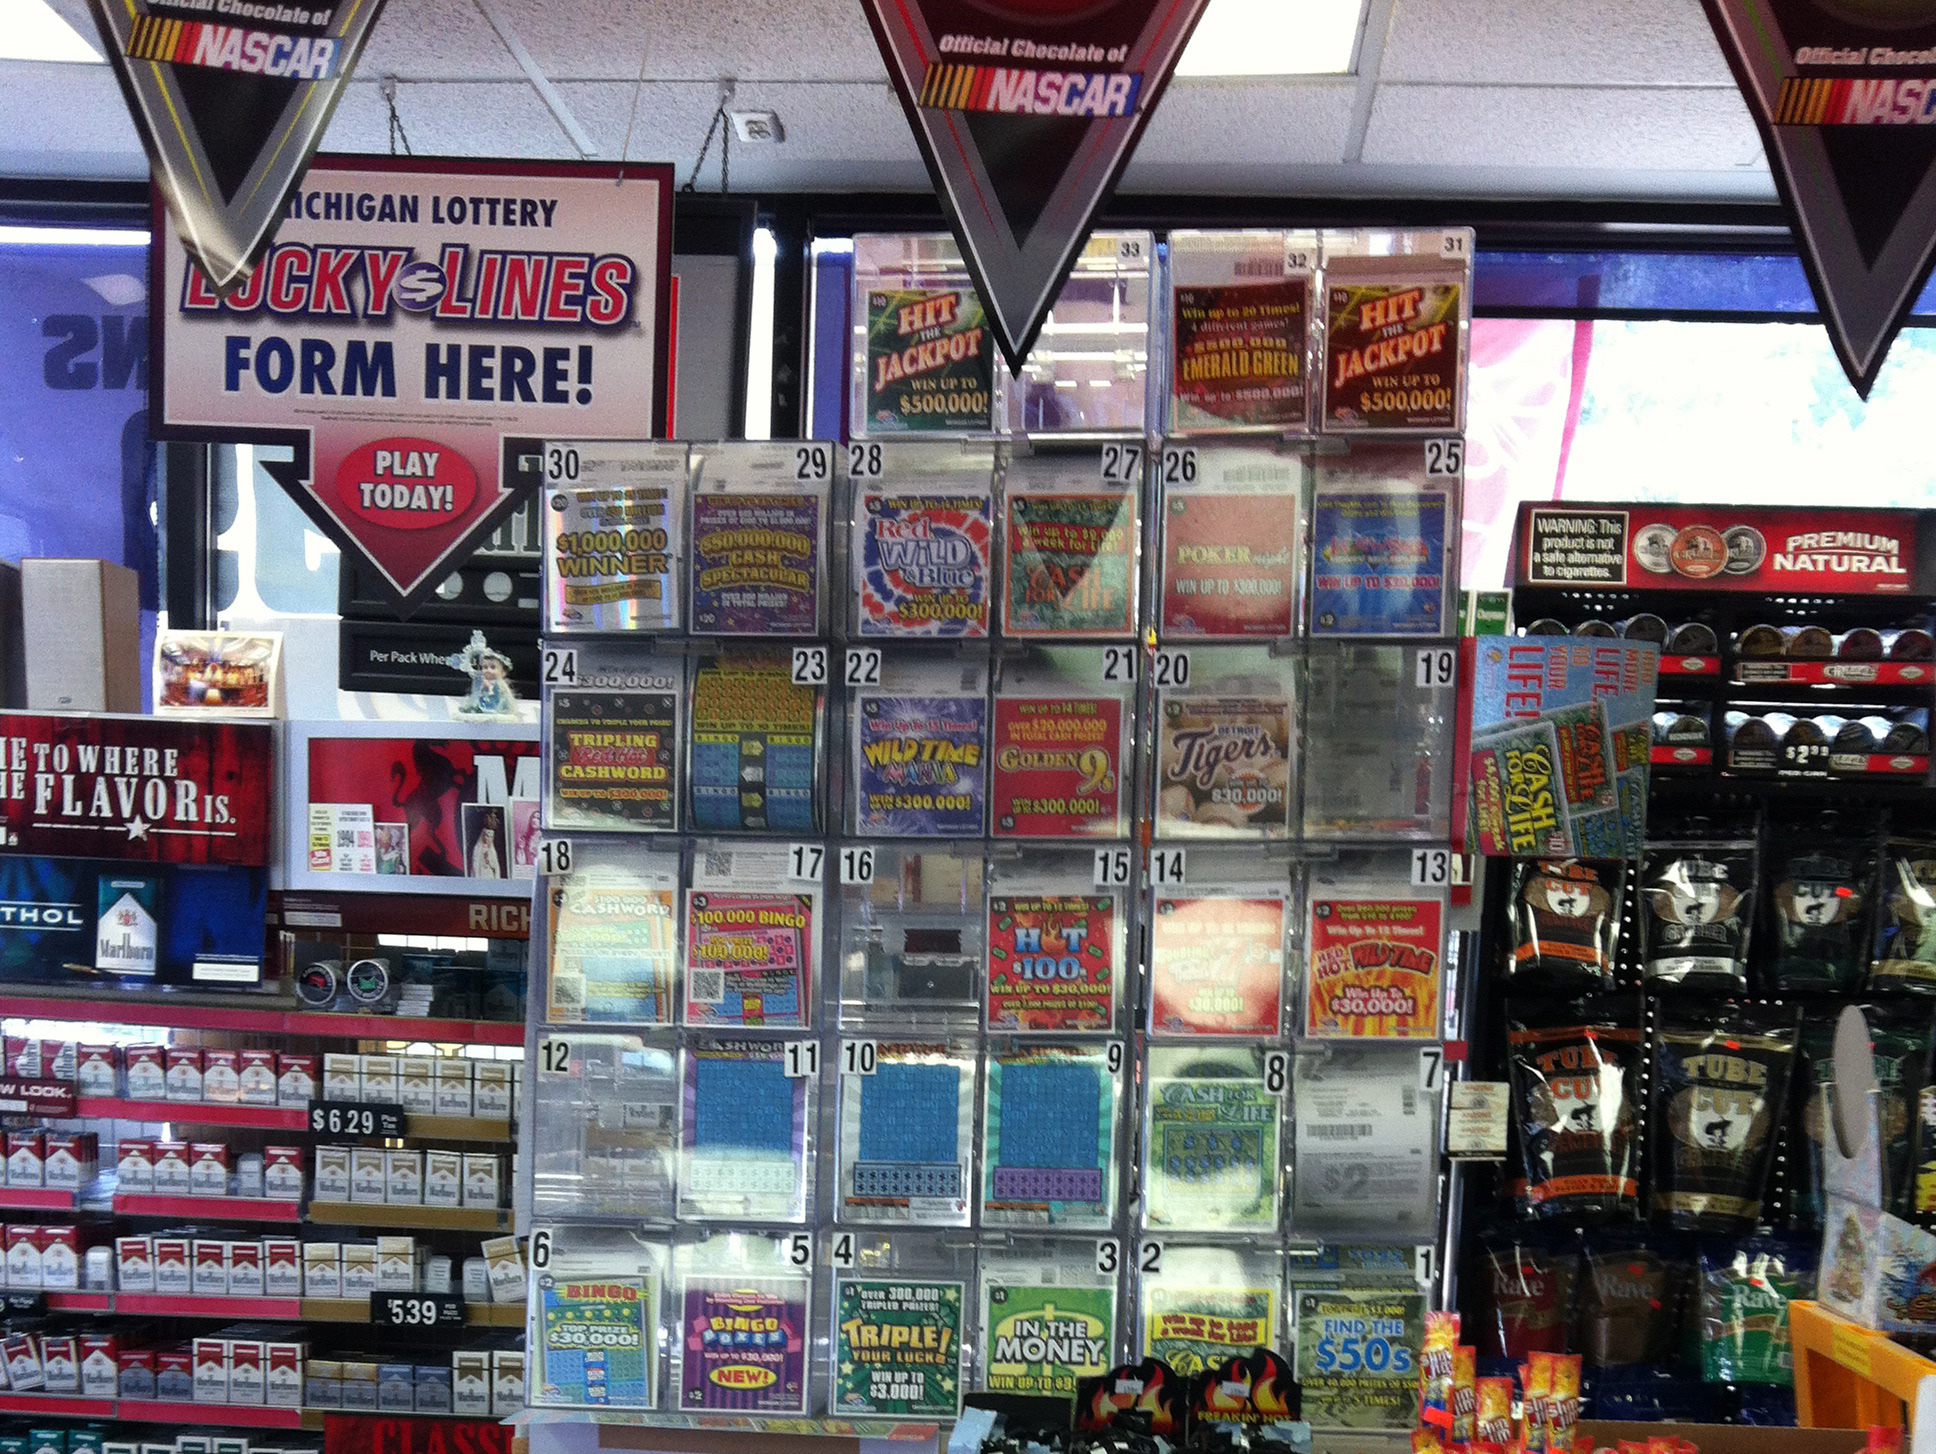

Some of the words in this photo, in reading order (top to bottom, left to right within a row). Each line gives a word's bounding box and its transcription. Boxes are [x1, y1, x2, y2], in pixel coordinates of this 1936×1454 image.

[312, 9, 332, 26] of
[193, 23, 334, 80] NASCAR
[939, 34, 1008, 56] Official
[1011, 38, 1104, 62] Chocolate
[1107, 44, 1127, 63] of
[1795, 47, 1868, 65] Official
[986, 67, 1131, 116] NASCAR
[432, 196, 558, 228] LOTTERY
[1120, 241, 1140, 257] 33
[1444, 237, 1462, 251] 31
[1288, 253, 1306, 269] 32
[432, 242, 638, 327] LINES
[898, 291, 960, 336] HIT
[1182, 307, 1206, 319] Win
[1208, 308, 1224, 321] up
[1227, 307, 1240, 318] to
[1259, 302, 1300, 317] Times!
[1360, 288, 1423, 332] HIT
[1200, 321, 1248, 333] different
[224, 335, 397, 399] FORM
[424, 343, 593, 405] HERE!
[874, 327, 983, 393] JACKPOT
[1183, 349, 1250, 381] EMERALD
[1252, 349, 1299, 378] GREEN
[1334, 323, 1446, 389] JACKPOT
[911, 379, 937, 391] WIN
[940, 378, 958, 390] UP
[960, 378, 977, 390] TO
[1372, 375, 1398, 387] WIN
[1403, 375, 1421, 387] UP
[1423, 375, 1440, 387] TO
[900, 393, 989, 415] $500,000!
[1360, 390, 1451, 412] $500,000!
[375, 450, 439, 478] PLAY
[549, 449, 579, 480] 30
[796, 448, 826, 479] 29
[851, 444, 882, 476] 28
[1103, 447, 1139, 480] 27
[1166, 451, 1196, 482] 26
[1428, 442, 1460, 474] 25
[359, 482, 453, 512] TODAY!
[1599, 519, 1622, 534] This
[556, 528, 668, 556] $1,000,000
[1177, 545, 1251, 565] POKER
[1542, 535, 1585, 551] product
[1586, 536, 1595, 549] is
[1596, 537, 1615, 550] not
[1786, 531, 1900, 554] PREMIUM
[556, 553, 669, 578] WINNER
[729, 550, 780, 567] CASH
[1533, 552, 1541, 563] a
[1542, 550, 1566, 563] safe
[1567, 551, 1623, 564] alternative
[1772, 553, 1907, 574] NATURAL
[701, 566, 811, 593] SPECTACULAR
[917, 566, 976, 588] Blue
[1543, 565, 1555, 576] to
[1556, 564, 1612, 579] cigarettes.
[1175, 579, 1197, 595] WIN
[898, 603, 983, 621] $300,000!
[370, 650, 389, 664] Per
[391, 651, 417, 665] Pack
[545, 651, 576, 682] 24
[795, 650, 825, 682] 23
[848, 653, 879, 683] 22
[1104, 649, 1134, 680] 21
[1157, 654, 1189, 685] 20
[1421, 652, 1452, 684] 19
[1547, 646, 1568, 690] YOUR
[1572, 647, 1591, 667] TO
[1504, 646, 1545, 719] LIFE!
[569, 733, 658, 748] TRIPLING
[863, 738, 919, 768] WILD
[921, 740, 980, 768] TIME
[33, 743, 70, 773] TO
[77, 744, 179, 777] WHERE
[999, 748, 1079, 771] GOLDEN
[1168, 722, 1273, 789] Tigers
[1505, 749, 1526, 788] FOR
[560, 765, 667, 780] CASHWORD
[882, 760, 960, 787] MANIA
[34, 773, 199, 822] FLAVOR
[203, 795, 237, 825] IS.
[1521, 744, 1557, 831] CASH
[1503, 783, 1538, 853] LIFE
[541, 841, 570, 872] 18
[793, 846, 823, 879] 17
[844, 851, 872, 881] 16
[1099, 852, 1128, 882] 15
[1154, 852, 1184, 882] 14
[1416, 851, 1446, 882] 13
[0, 906, 83, 925] THOL
[759, 911, 807, 930] BINGO
[99, 933, 155, 961] Marlboro
[990, 984, 1012, 995] WIN
[1330, 997, 1415, 1015] $30,000!
[541, 1041, 569, 1072] 12
[788, 1044, 816, 1074] 11
[845, 1043, 875, 1073] 10
[1107, 1044, 1121, 1073] 9
[1422, 1051, 1441, 1089] 7
[1681, 1053, 1769, 1084] TUBE
[1267, 1055, 1285, 1093] 8
[20, 1084, 72, 1099] LOOK.
[1161, 1082, 1224, 1104] CASH
[1692, 1087, 1758, 1115] CUT
[1220, 1101, 1272, 1121] LIFE
[532, 1231, 550, 1268] 6
[791, 1235, 809, 1265] 5
[834, 1235, 852, 1265] 4
[1098, 1242, 1117, 1272] 3
[1141, 1243, 1161, 1273] 2
[1420, 1250, 1430, 1279] 1
[566, 1284, 637, 1302] BINGO
[861, 1289, 885, 1301] OVER
[902, 1302, 939, 1313] PRIZES!
[549, 1331, 639, 1346] $30,000!
[561, 1324, 587, 1334] TOP
[589, 1324, 629, 1334] PRIZE
[710, 1316, 778, 1333] BINGO
[841, 1317, 952, 1356] TRIPLE!
[1015, 1320, 1042, 1338] IN
[1046, 1320, 1089, 1339] THE
[1324, 1318, 1367, 1336] FIND
[1371, 1319, 1405, 1336] THE
[852, 1351, 892, 1364] YOUR
[897, 1351, 934, 1364] LUCK
[995, 1336, 1106, 1365] MONEY
[1315, 1335, 1412, 1376] $50s
[717, 1370, 769, 1385] NEW!
[871, 1371, 892, 1384] WIN
[895, 1372, 909, 1384] UP
[911, 1372, 925, 1384] TO
[988, 1376, 1014, 1390] WIN
[1017, 1377, 1033, 1391] UP
[1037, 1377, 1052, 1391] TO
[869, 1384, 925, 1400] $3,000!
[1197, 1410, 1259, 1424] FREAKIN'
